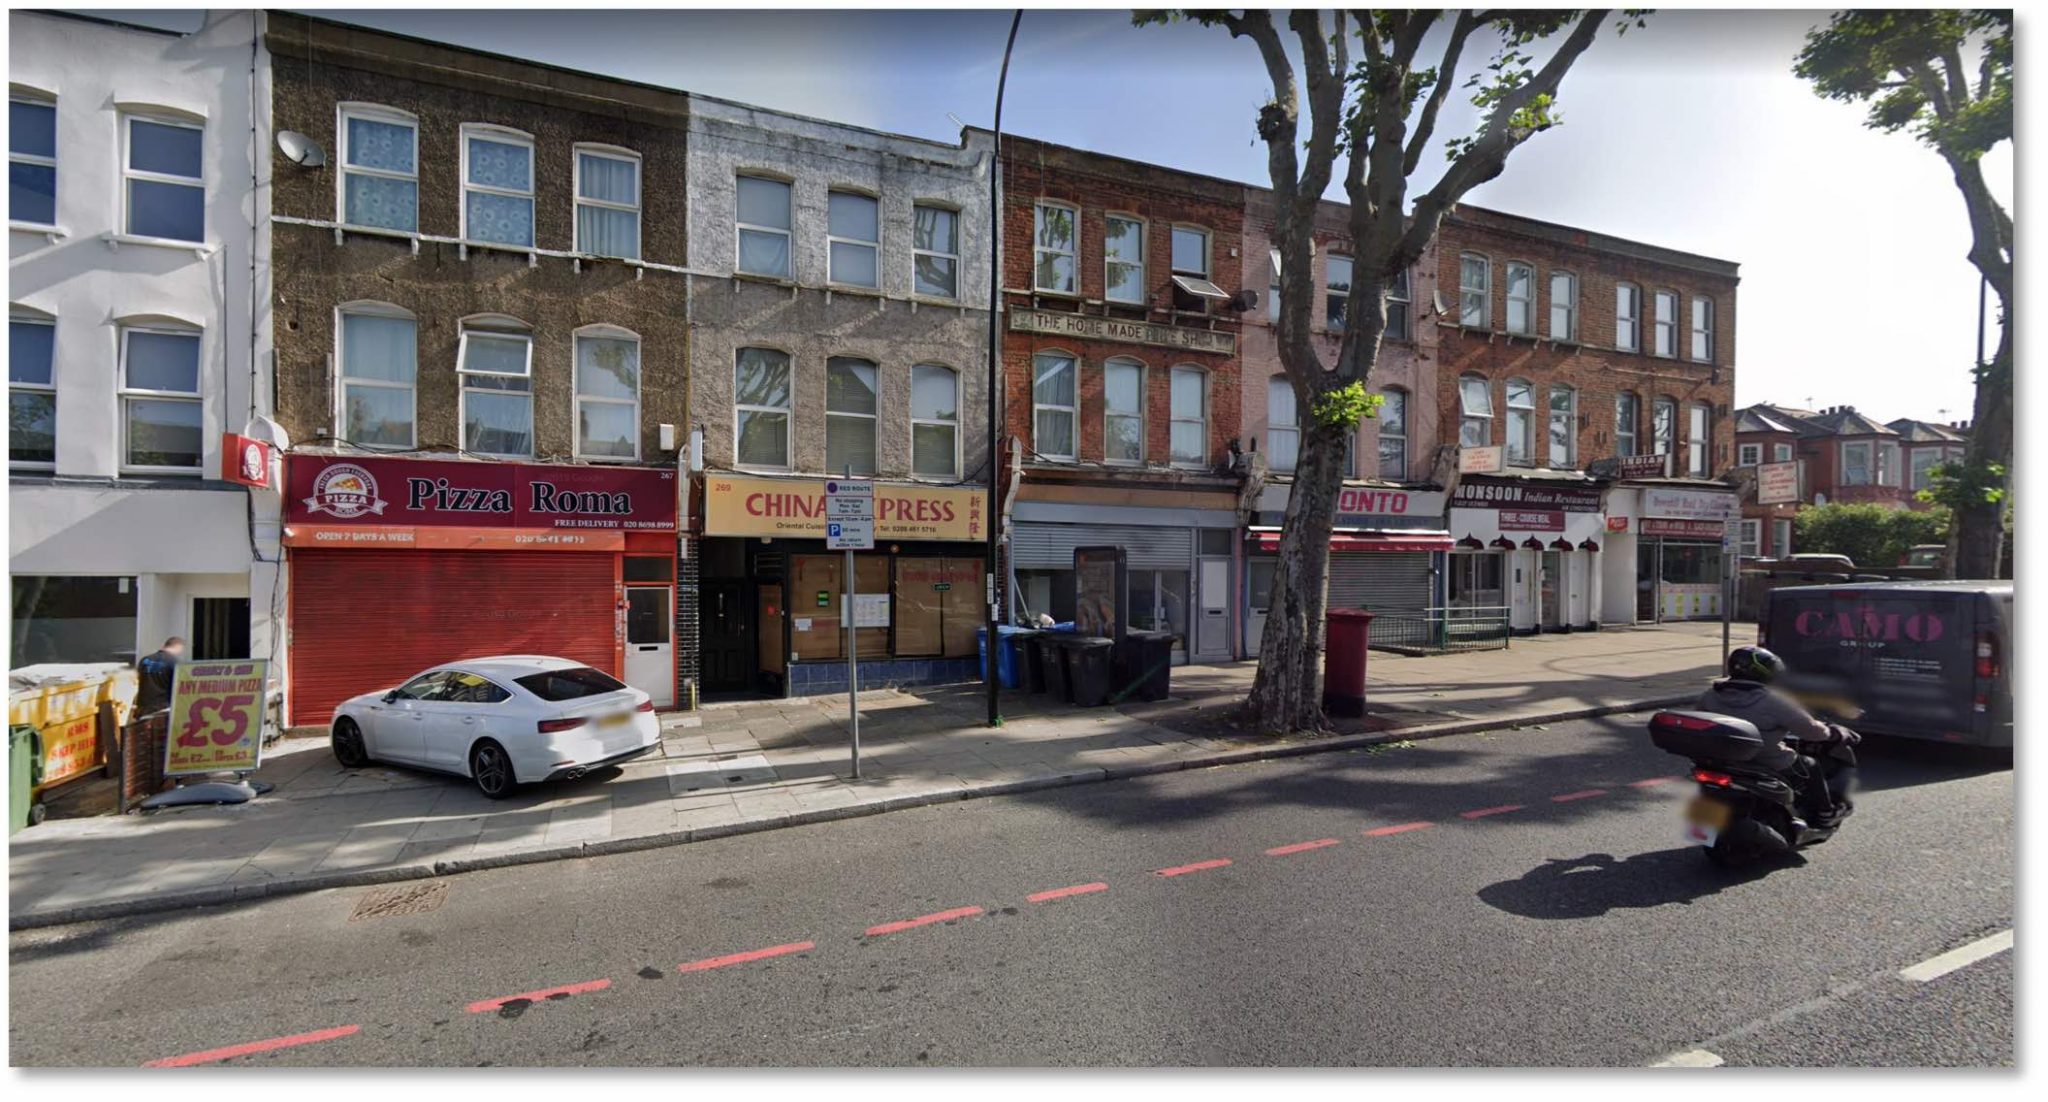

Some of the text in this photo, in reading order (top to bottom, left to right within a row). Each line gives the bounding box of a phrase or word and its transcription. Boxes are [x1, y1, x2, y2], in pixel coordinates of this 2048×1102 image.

[1036, 314, 1060, 330] THE
[1108, 324, 1141, 338] MADE
[1622, 456, 1664, 466] INDIAN
[407, 477, 633, 515] Pizza Roma
[716, 483, 731, 492] 269
[1455, 485, 1598, 504] MONSOON Indian Restaurant
[326, 494, 367, 504] PIZZA
[746, 493, 955, 521] CHINA PRESS
[1340, 491, 1408, 513] ONTO
[316, 532, 414, 542] OPEN 7 DAYS A WEEK
[1795, 607, 1944, 642] CAMO
[178, 678, 262, 694] ANY MEDIUM PIZZA
[176, 694, 254, 748] £5
